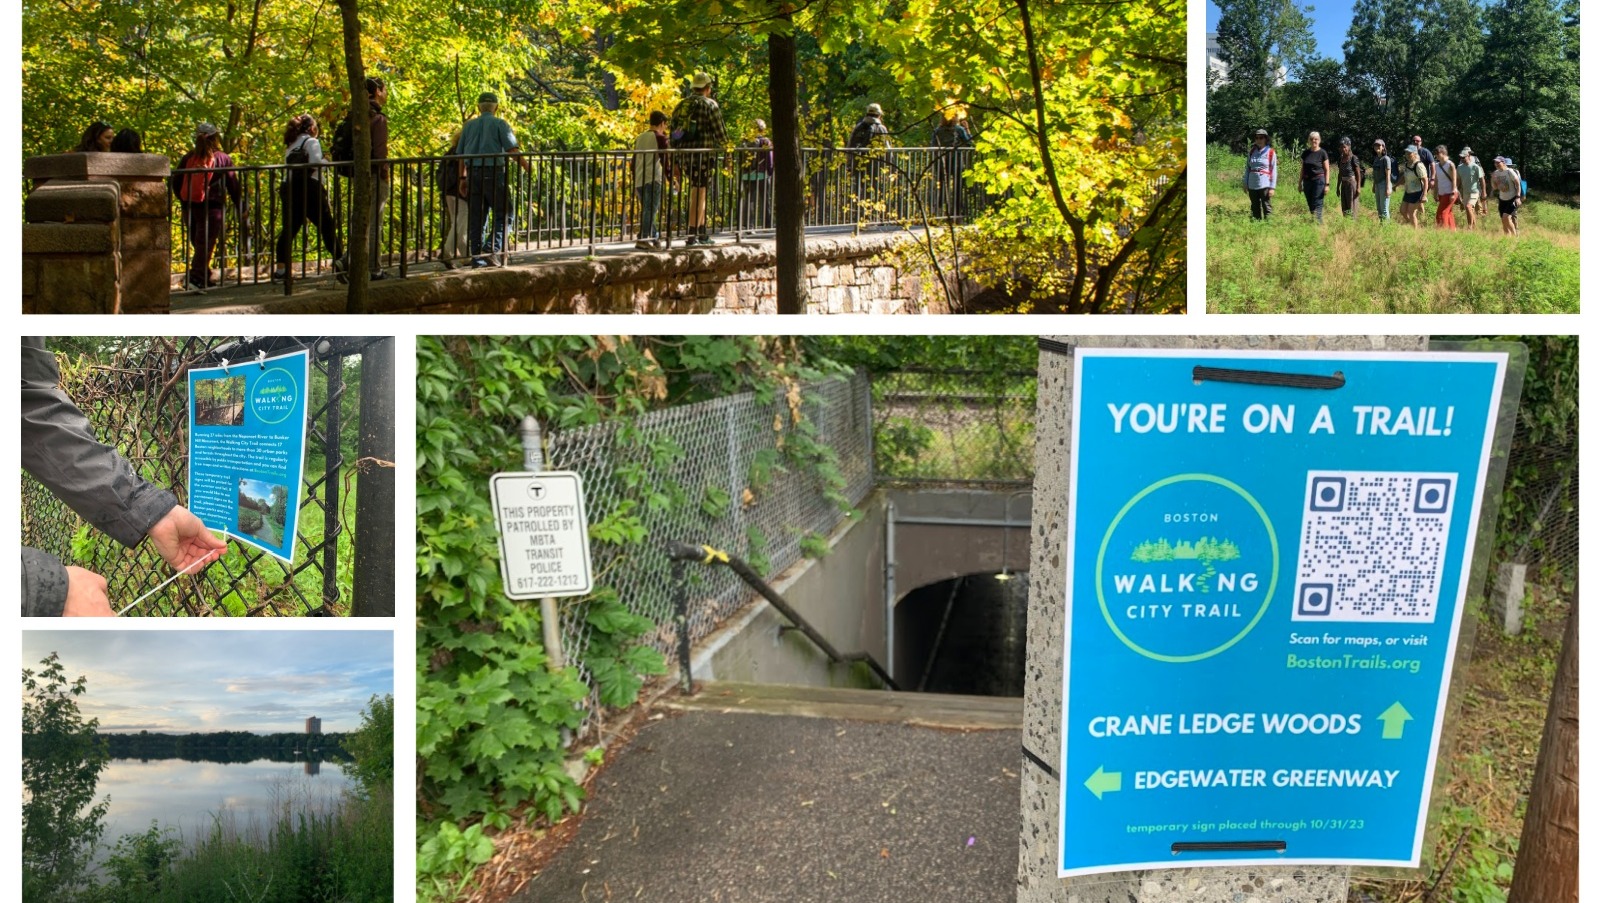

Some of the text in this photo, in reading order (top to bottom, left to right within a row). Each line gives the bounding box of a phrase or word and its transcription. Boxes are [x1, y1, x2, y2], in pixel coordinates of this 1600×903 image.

[1107, 402, 1455, 437] YOU'RE ON A TRAIL!
[531, 487, 542, 497] T
[502, 505, 575, 519] THIS PROPERTY
[1163, 512, 1219, 523] BOSTON
[506, 520, 574, 533] PATROLLED BY
[530, 534, 556, 546] MBTA
[525, 548, 564, 560] TRANSIT
[530, 562, 563, 574] POLICE
[517, 574, 578, 589] 617-222-1212
[1126, 603, 1242, 619] CITY TRAIL
[1289, 632, 1429, 649] Scan for maps, or visit
[1286, 653, 1421, 674] BostonTrails.org
[1088, 712, 1362, 738] CRANE LEDGE WOODS
[1134, 768, 1401, 790] EDGEWATER GREENWAY
[1126, 818, 1365, 835] temporary sign placed through 10/31/23
